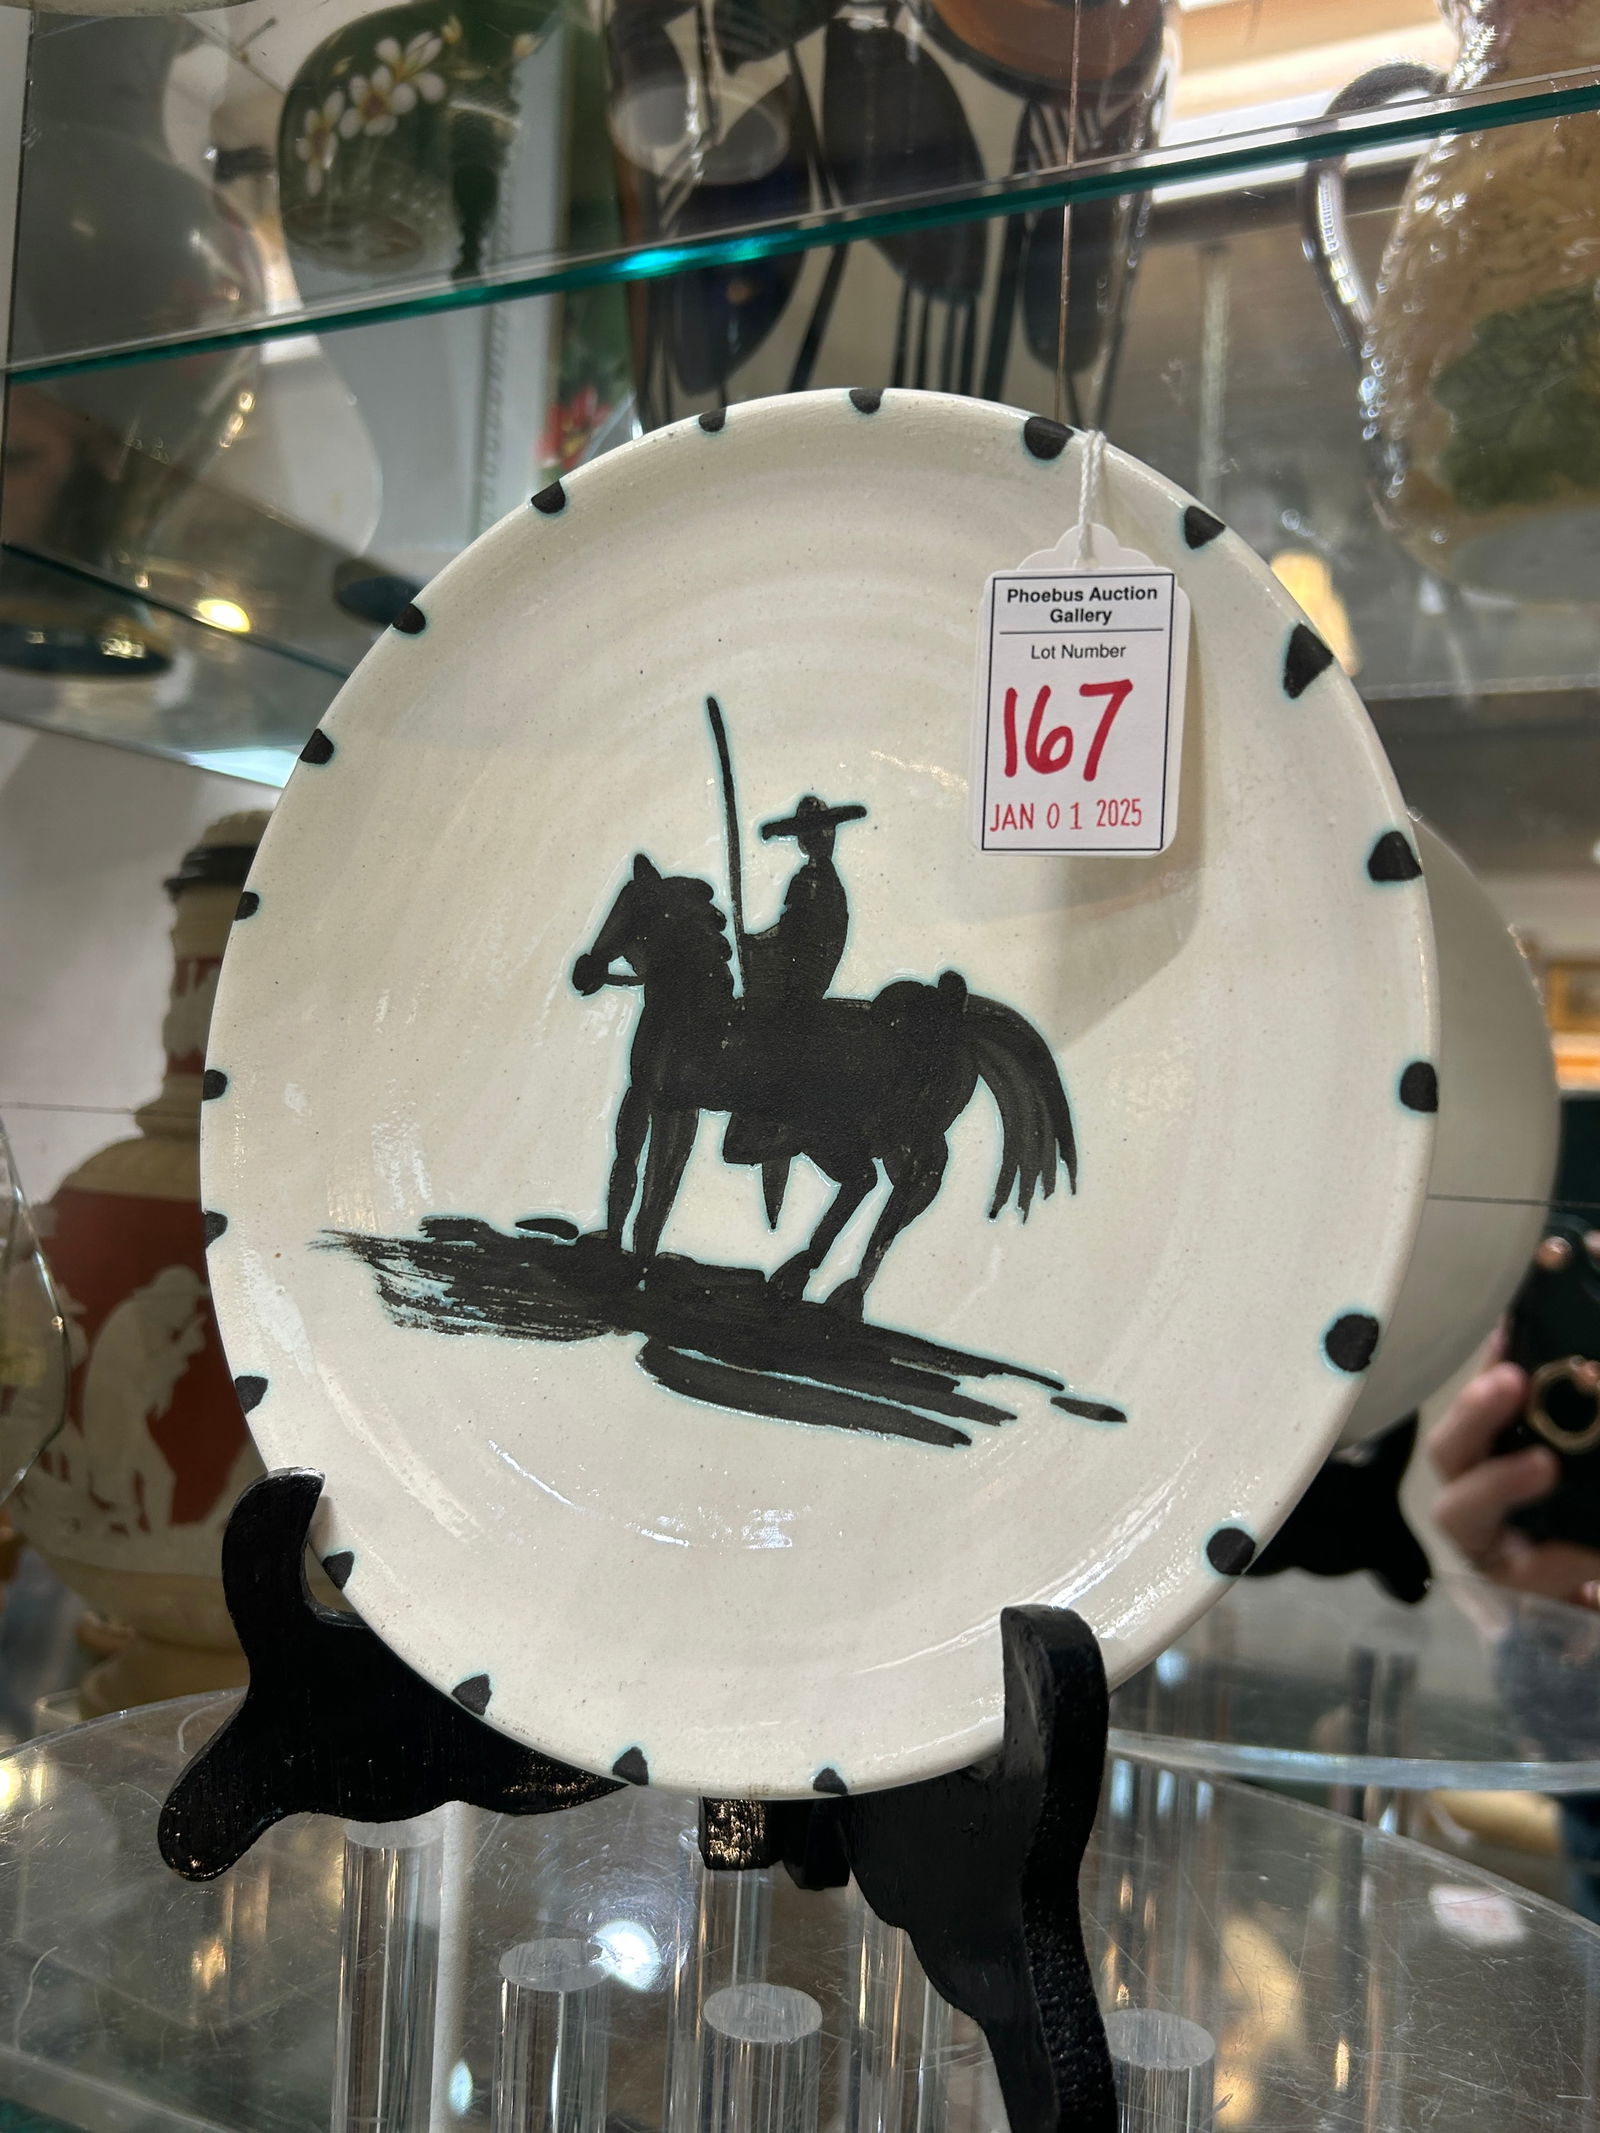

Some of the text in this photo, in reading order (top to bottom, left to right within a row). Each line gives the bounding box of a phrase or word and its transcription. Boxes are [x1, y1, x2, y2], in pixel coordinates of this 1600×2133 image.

[1007, 586, 1158, 603] Phoebus Auction
[1050, 608, 1112, 625] Gallery
[1031, 644, 1126, 660] Lot Number
[1004, 679, 1133, 782] 167
[990, 803, 1034, 832] JAN
[1096, 798, 1142, 827] 2025
